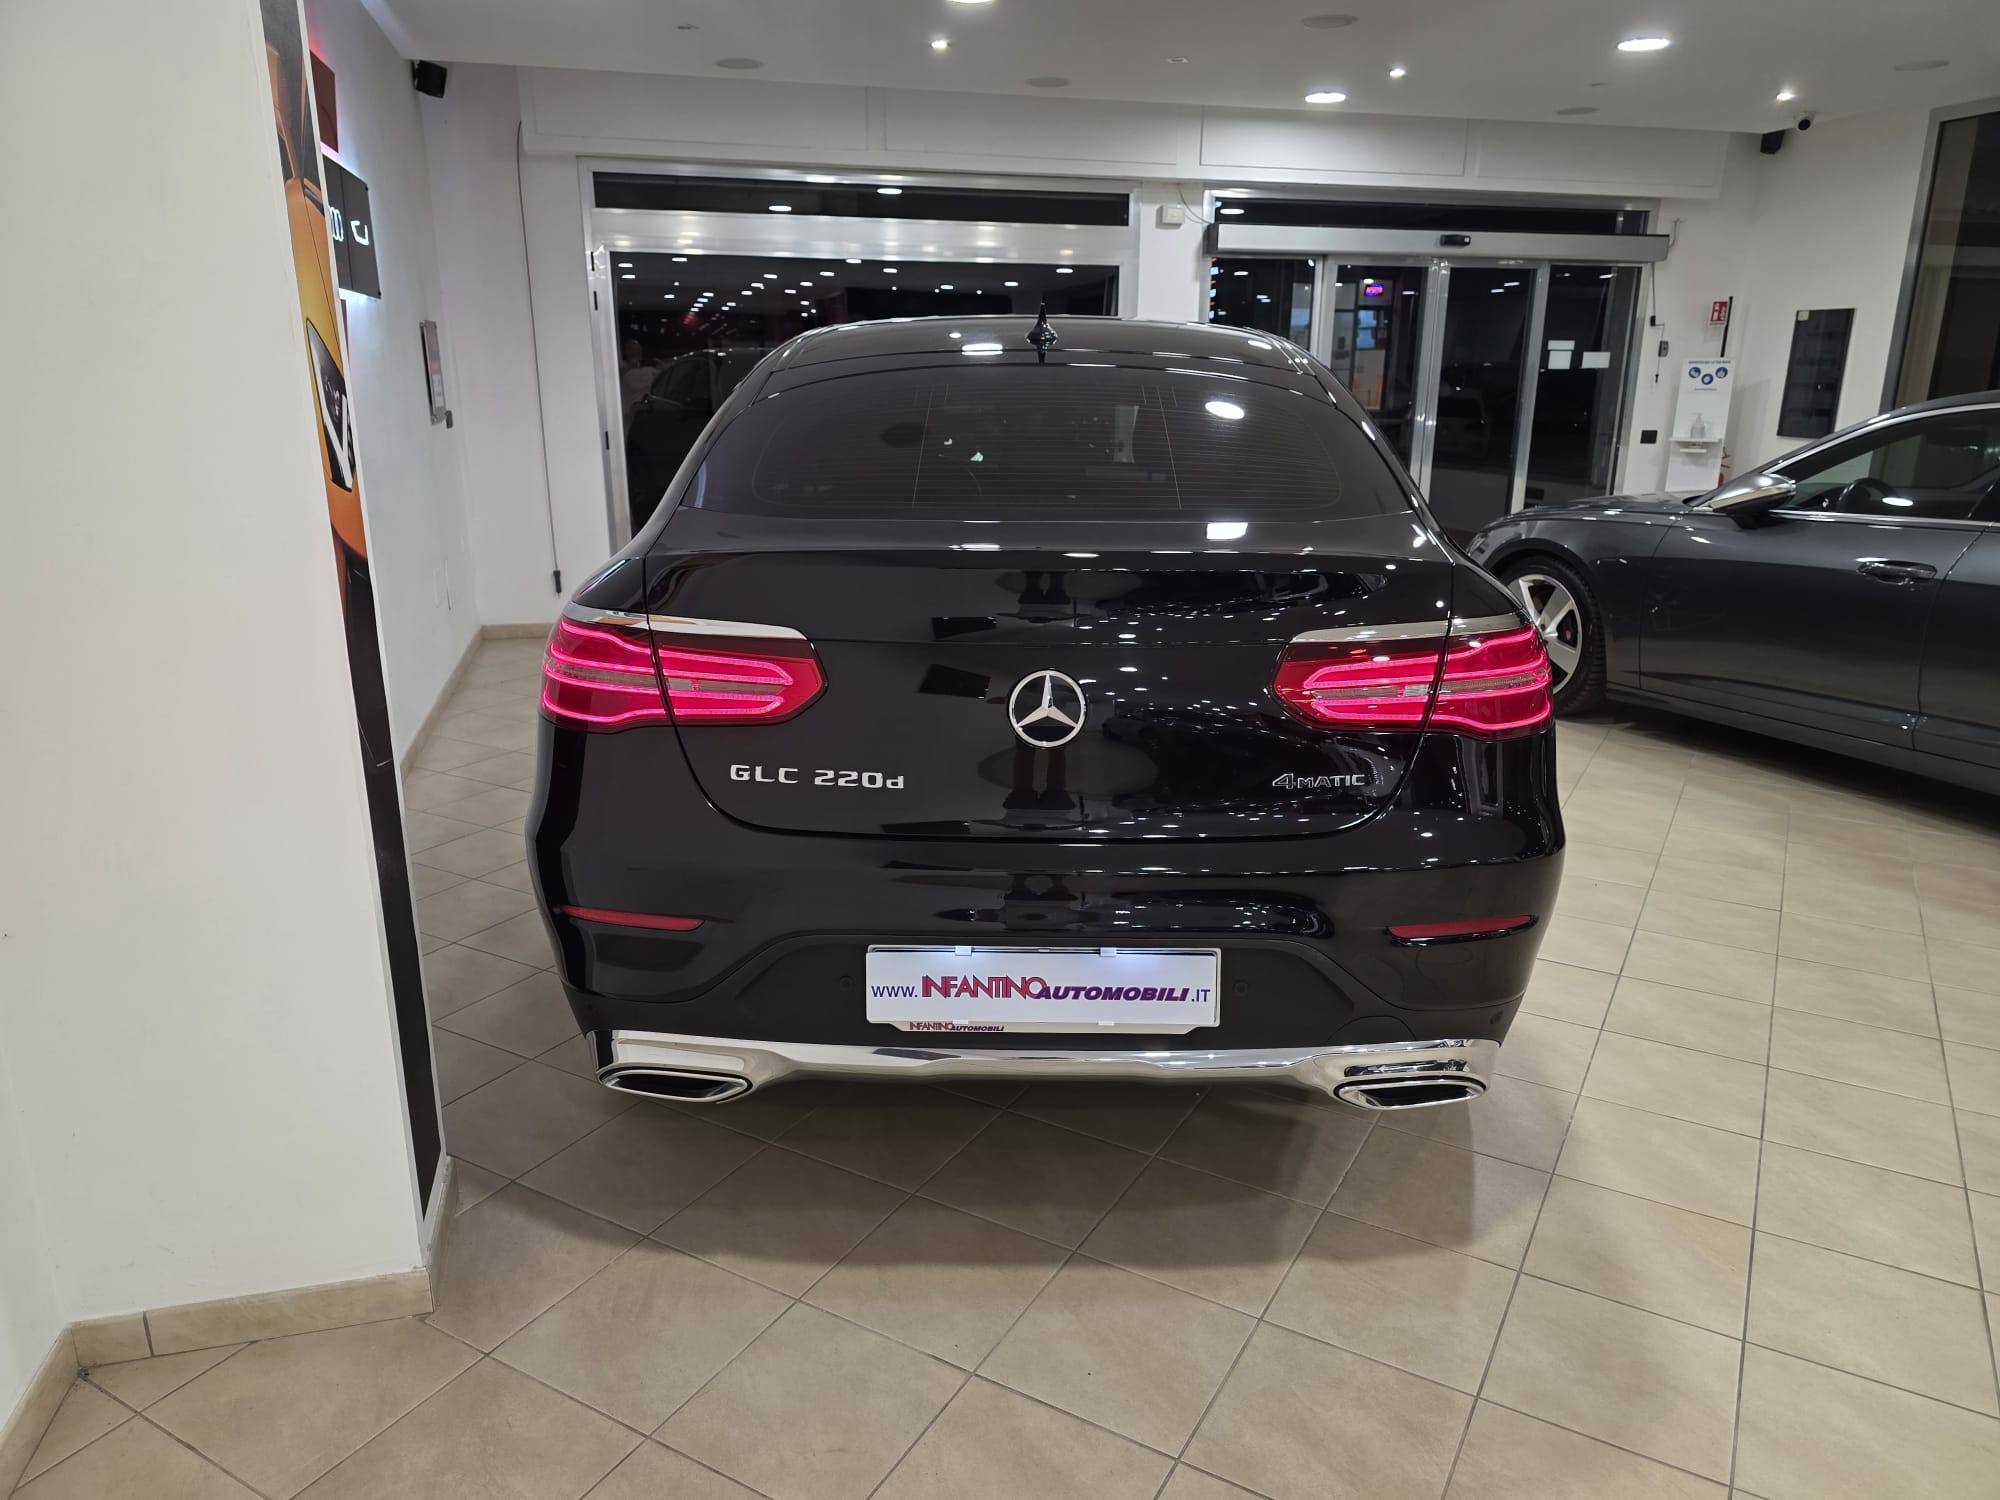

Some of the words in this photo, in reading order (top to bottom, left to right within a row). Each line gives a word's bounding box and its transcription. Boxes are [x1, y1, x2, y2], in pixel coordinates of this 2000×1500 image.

[730, 764, 799, 784] GLC
[814, 769, 905, 789] 220d
[1272, 773, 1366, 790] 4MATIC
